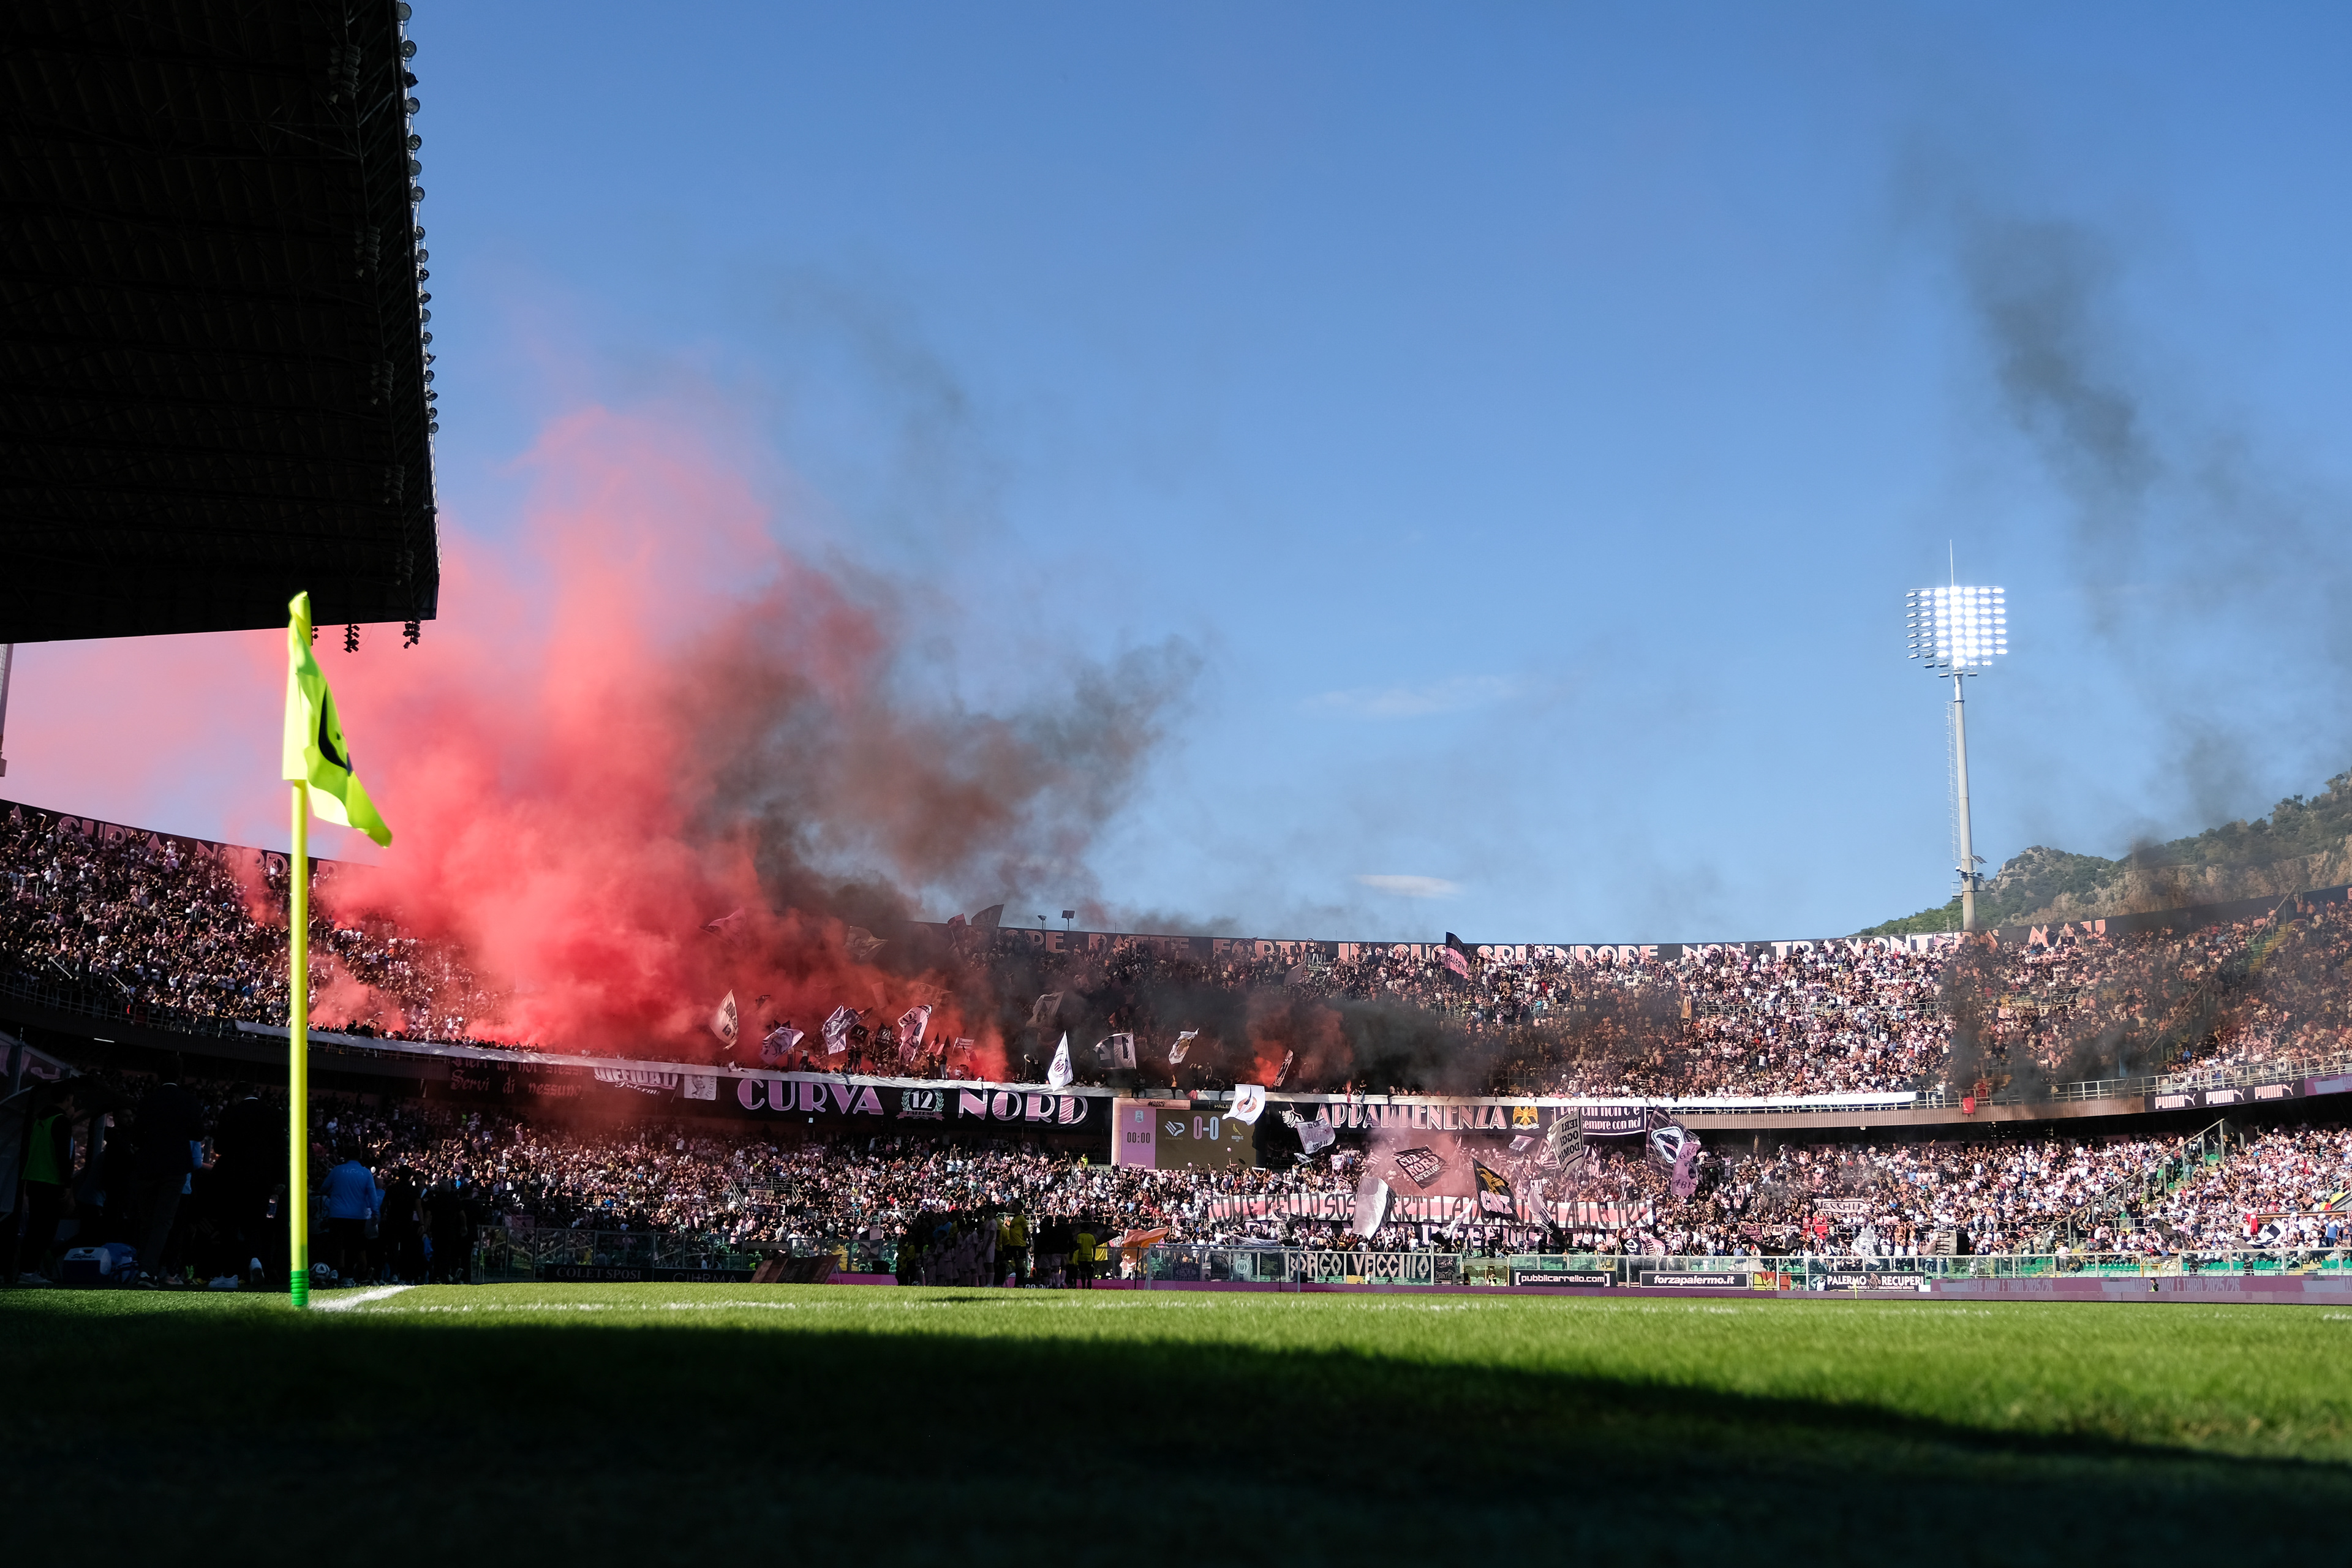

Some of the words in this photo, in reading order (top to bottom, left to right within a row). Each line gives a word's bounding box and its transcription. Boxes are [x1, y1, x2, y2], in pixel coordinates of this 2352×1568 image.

[450, 1069, 490, 1091] Servi
[502, 1075, 515, 1095] di
[528, 1082, 582, 1097] nessuno
[737, 1079, 884, 1115] CURVA
[2206, 1089, 2235, 1105] PUMA
[2255, 1084, 2283, 1099] PUMA
[911, 1090, 933, 1109] 12
[957, 1087, 1088, 1125] NORD
[2155, 1095, 2185, 1109] PUMA
[1316, 1103, 1507, 1131] APPARTENENZA
[1583, 1120, 1611, 1130] sempre
[1613, 1120, 1627, 1130] con
[1628, 1117, 1642, 1129] noi
[1127, 1132, 1150, 1144] 00:00
[1405, 1155, 1439, 1177] NORD
[556, 1266, 603, 1280] COLET
[605, 1268, 641, 1281] SPOSI
[1654, 1275, 1735, 1286] forzapalermo.it
[1826, 1275, 1867, 1286] PALERMO
[1881, 1275, 1924, 1286] RECUPERI
[2025, 1279, 2053, 1291] 2025/26
[2205, 1278, 2240, 1291] 2025/26
